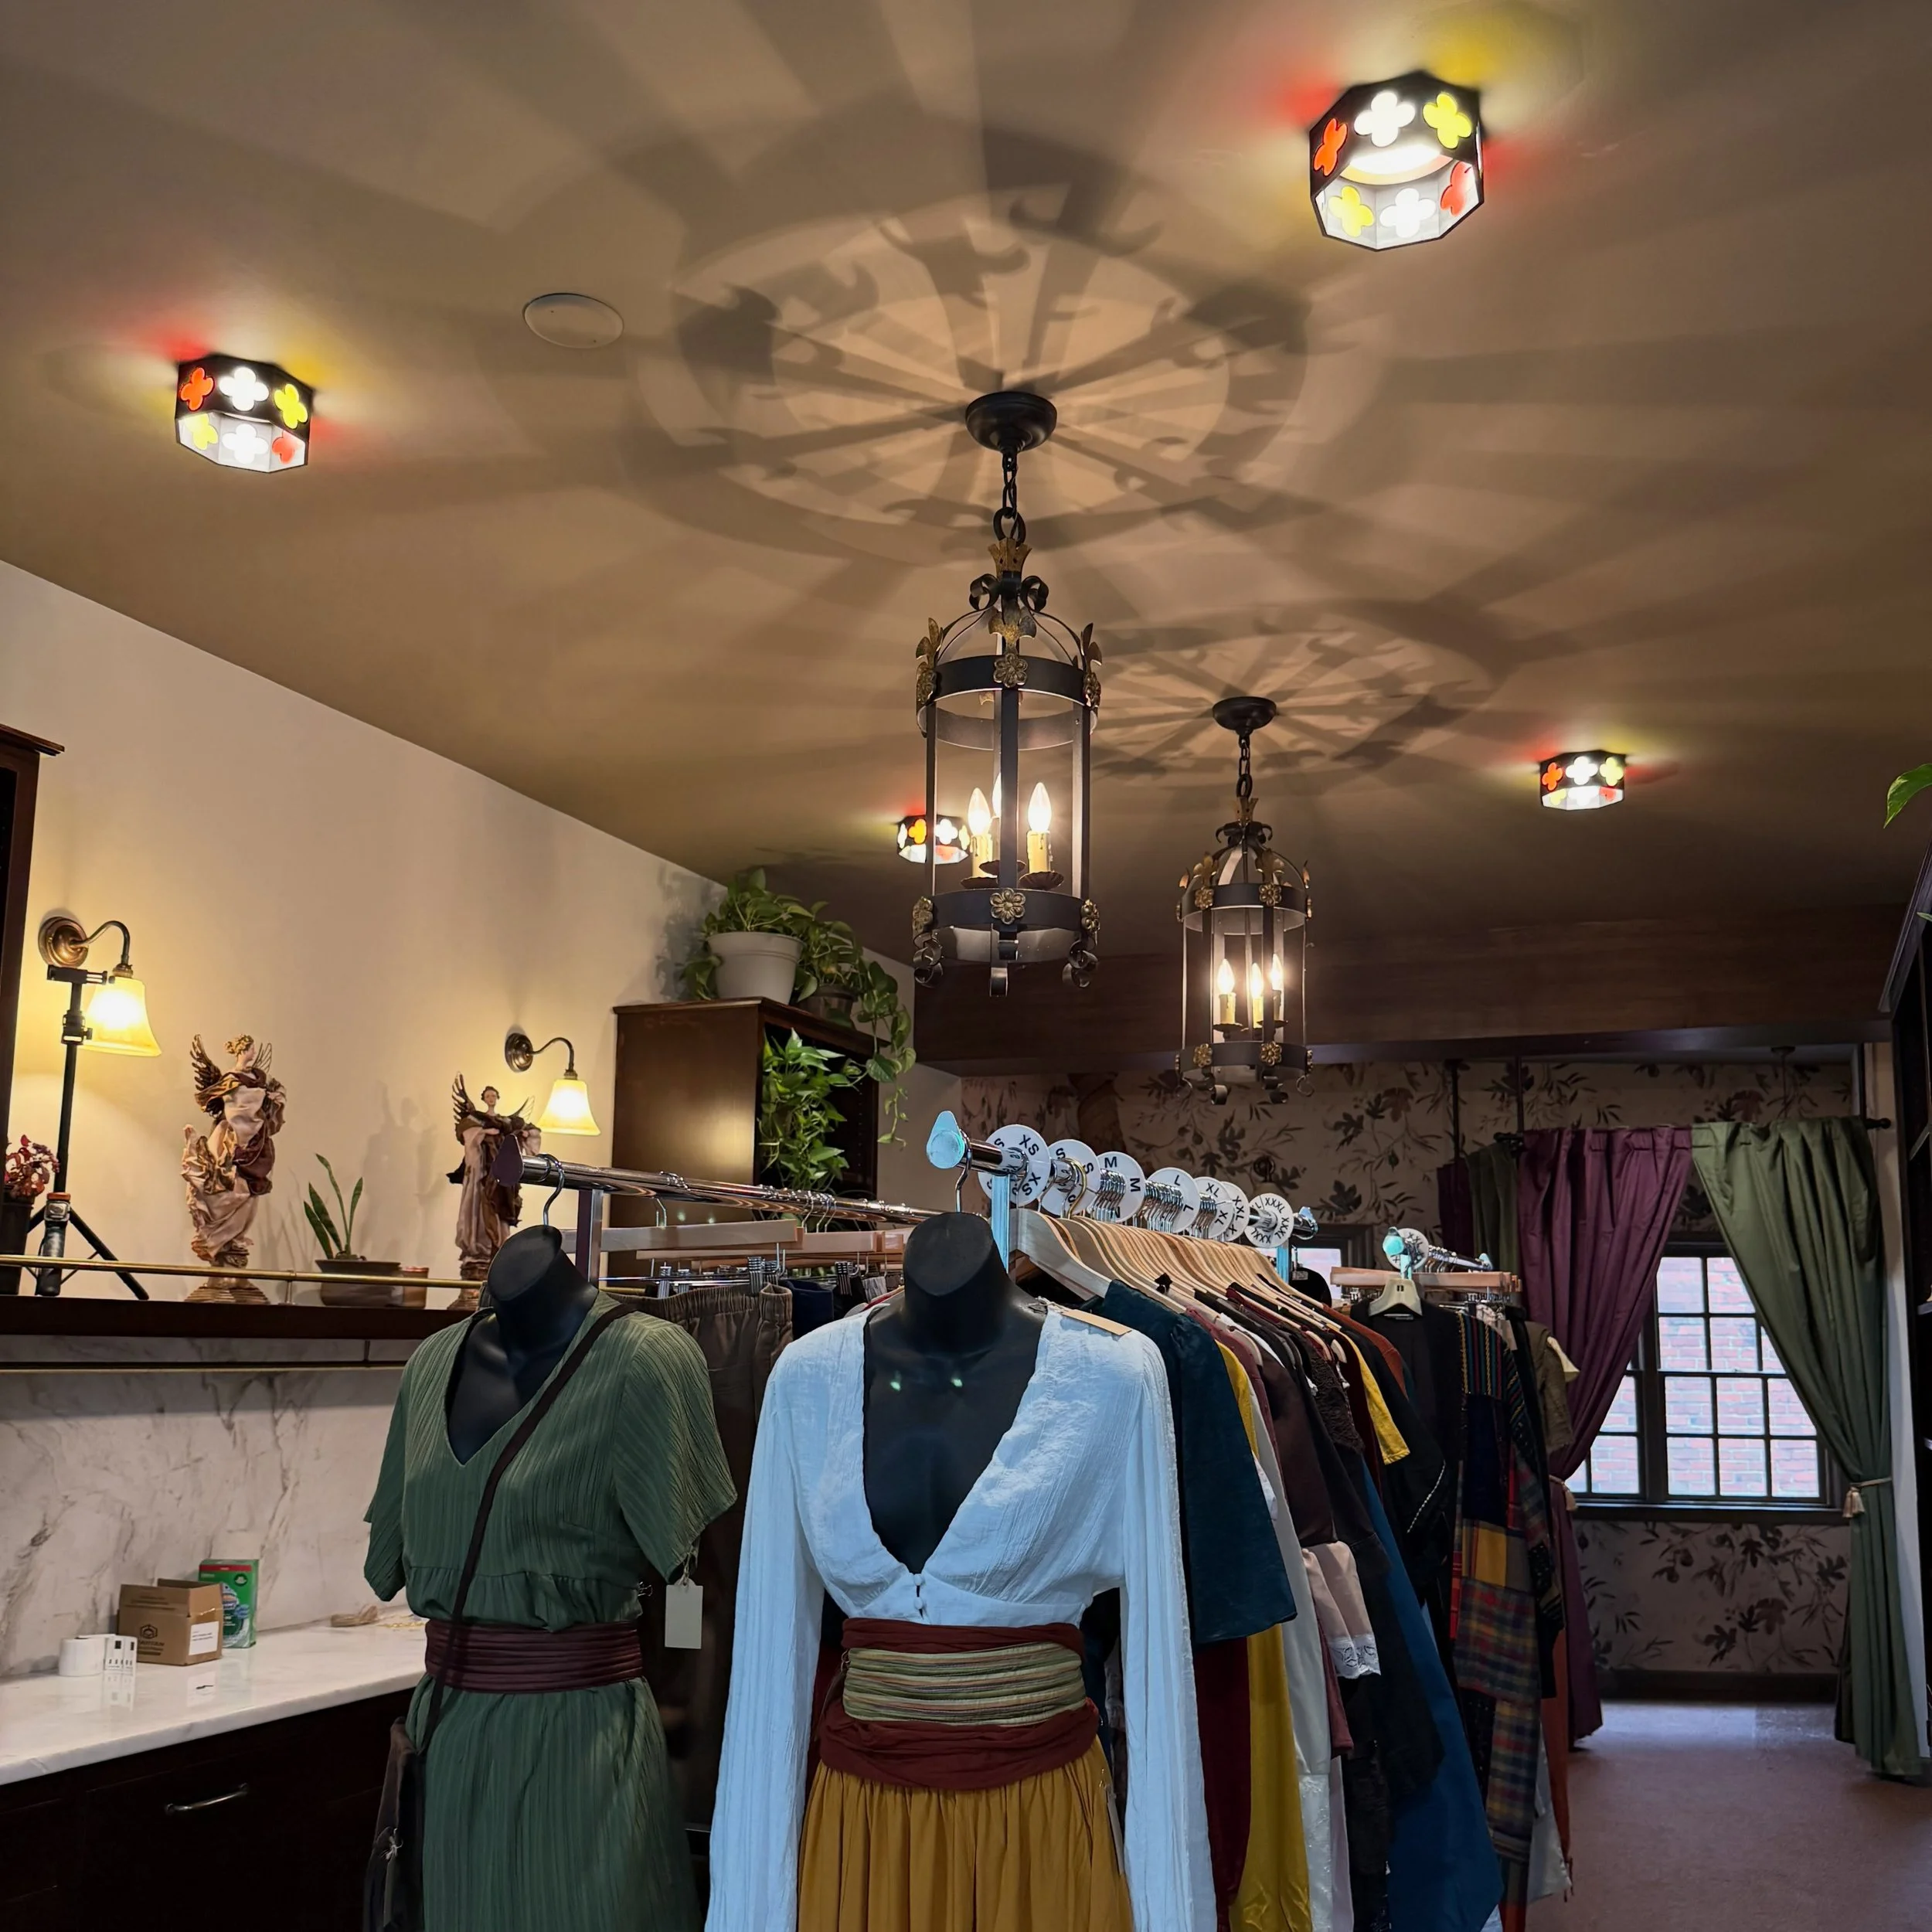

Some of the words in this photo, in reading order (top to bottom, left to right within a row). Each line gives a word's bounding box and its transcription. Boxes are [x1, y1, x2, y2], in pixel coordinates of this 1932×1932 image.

[1019, 1134, 1039, 1155] XS
[1056, 1148, 1066, 1160] S
[1083, 1162, 1094, 1174] S
[1104, 1156, 1117, 1168] M
[1022, 1172, 1041, 1196] XS
[1130, 1178, 1141, 1192] M
[1174, 1175, 1181, 1186] L
[1206, 1182, 1219, 1198] XL
[1182, 1204, 1194, 1213] L
[1232, 1196, 1245, 1220] XXL
[1265, 1197, 1285, 1213] XXXL
[1214, 1210, 1228, 1225] XL
[1250, 1227, 1271, 1244] XXXL
[1274, 1217, 1290, 1240] XXXL
